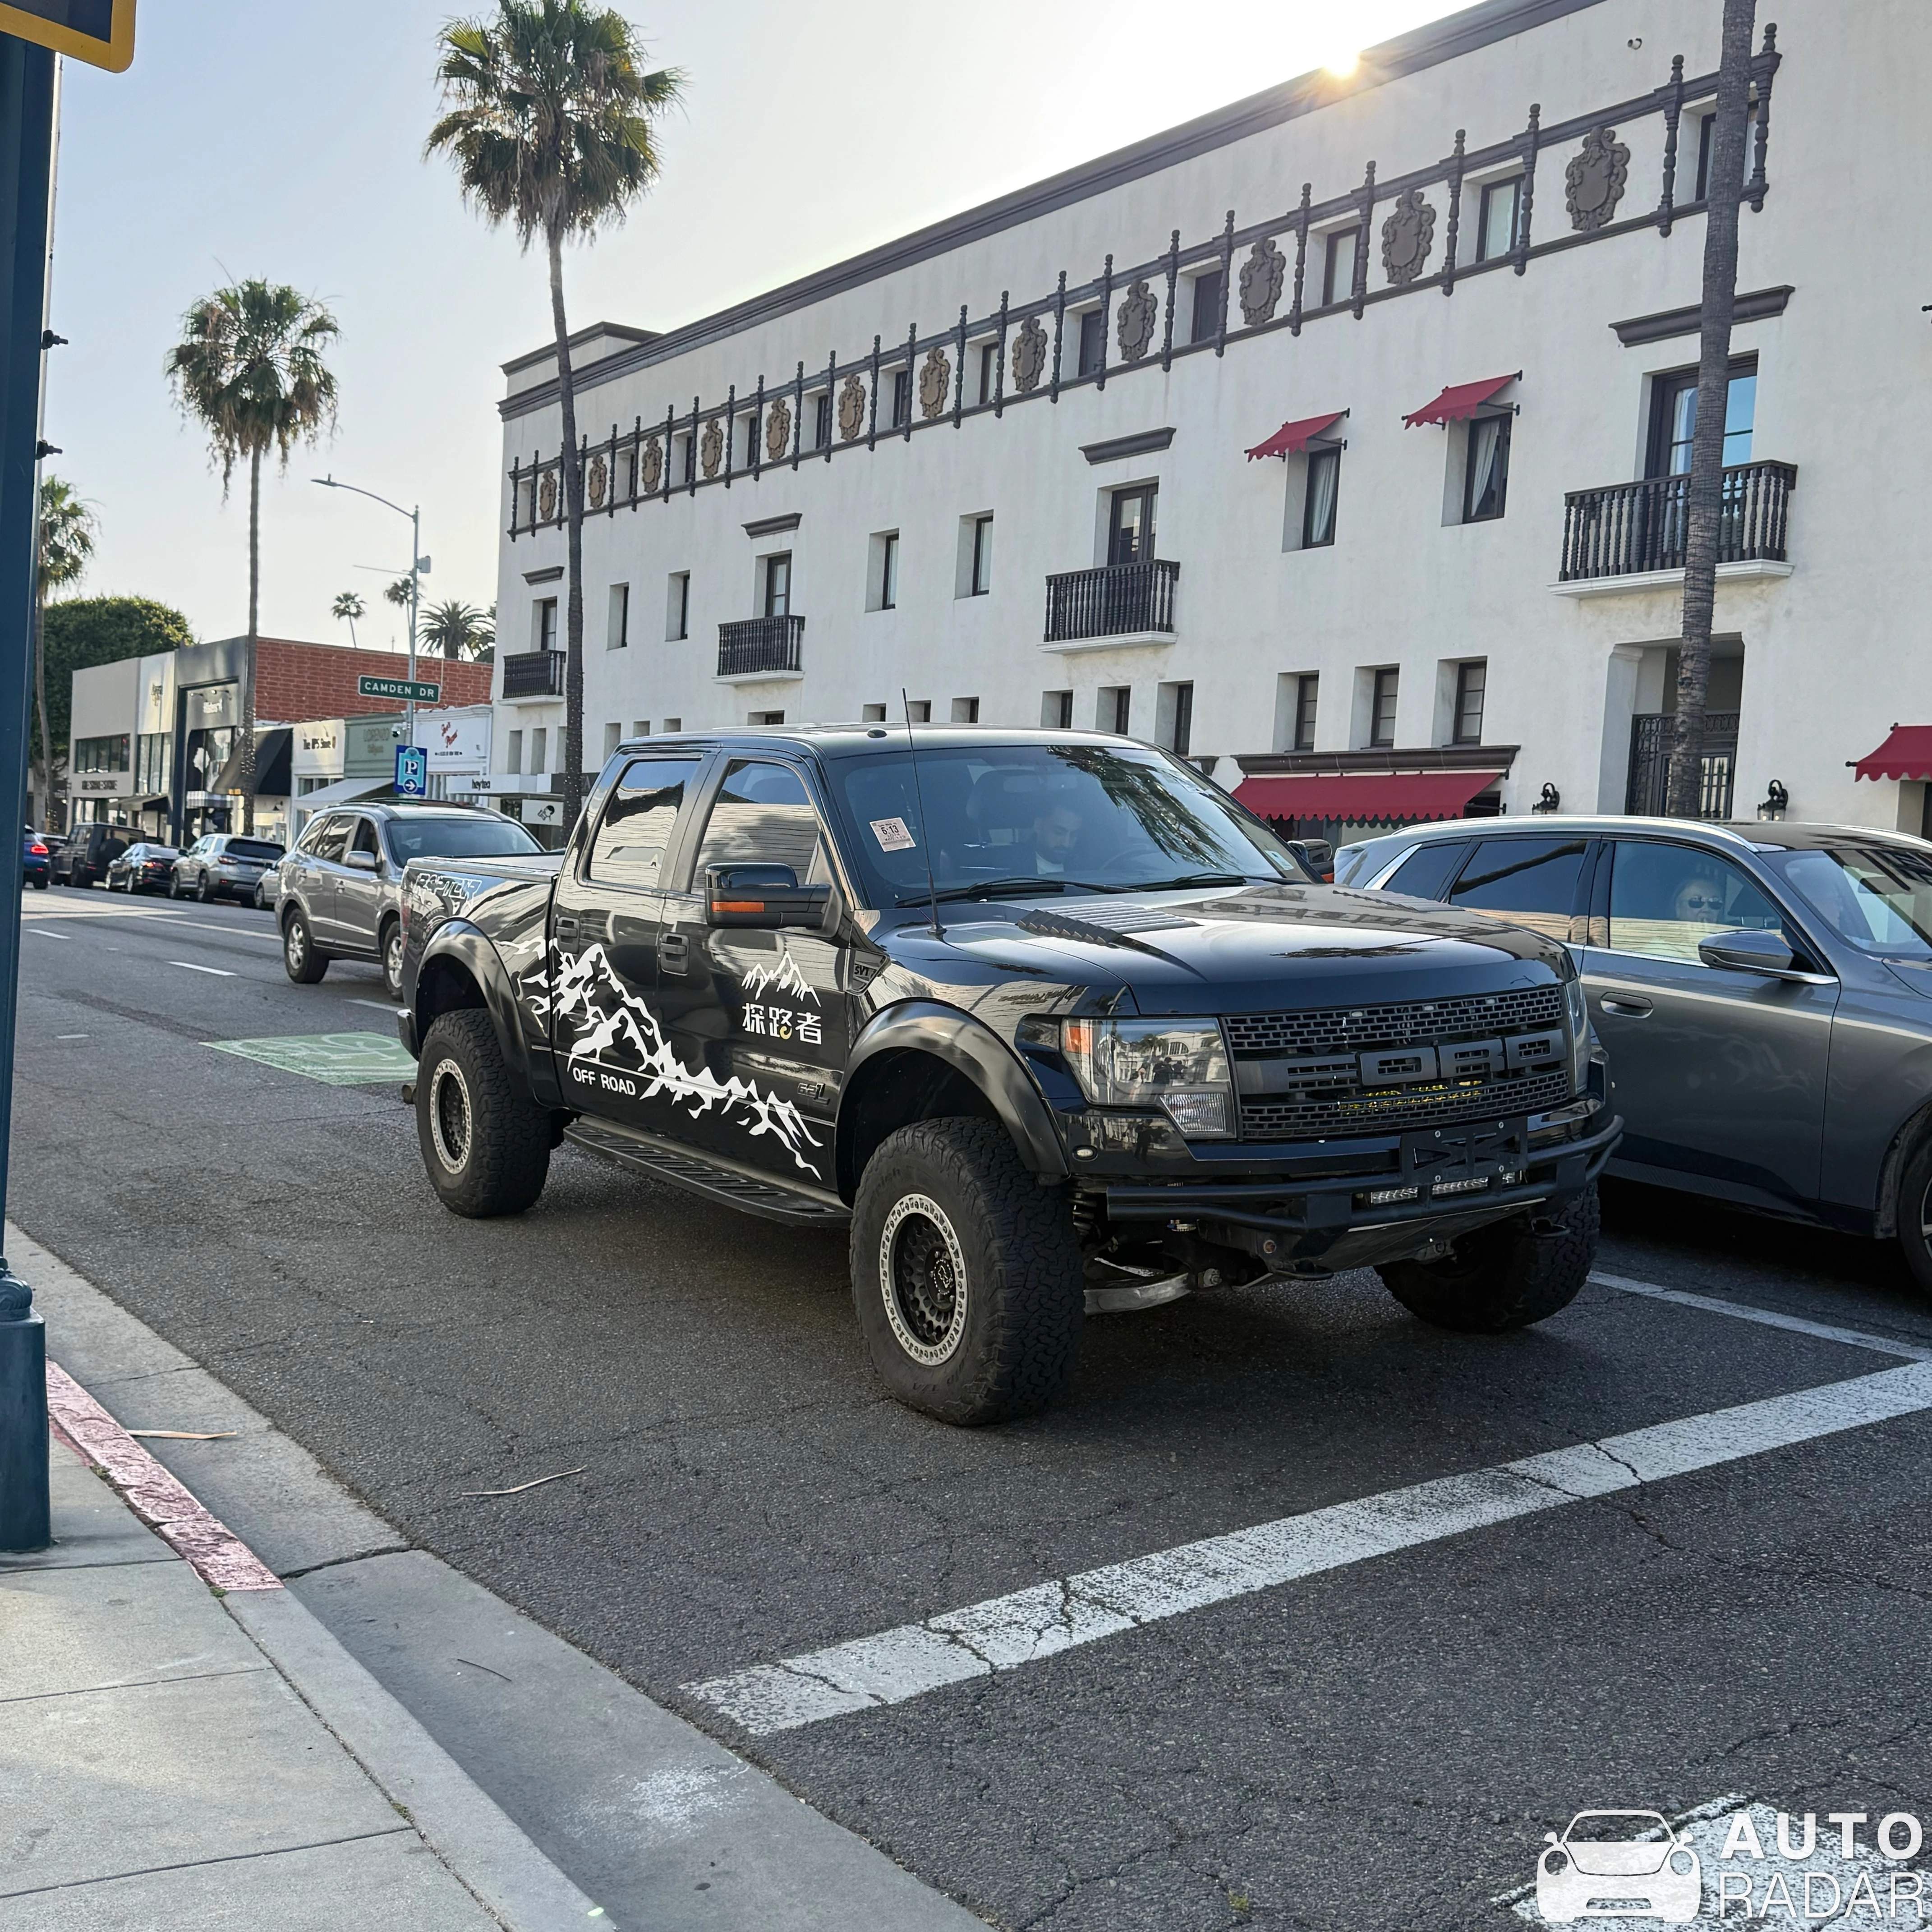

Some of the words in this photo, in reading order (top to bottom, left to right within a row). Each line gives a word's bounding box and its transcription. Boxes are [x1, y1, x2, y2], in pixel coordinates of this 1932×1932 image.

[365, 682, 411, 695] CAMDEN
[419, 688, 434, 697] DR
[406, 761, 417, 774] P
[472, 779, 490, 791] heytea
[854, 965, 869, 976] SVT
[742, 1003, 822, 1045] 探路者
[1235, 1030, 1566, 1095] FORD
[573, 1067, 596, 1085] OFF
[600, 1074, 636, 1095] ROAD
